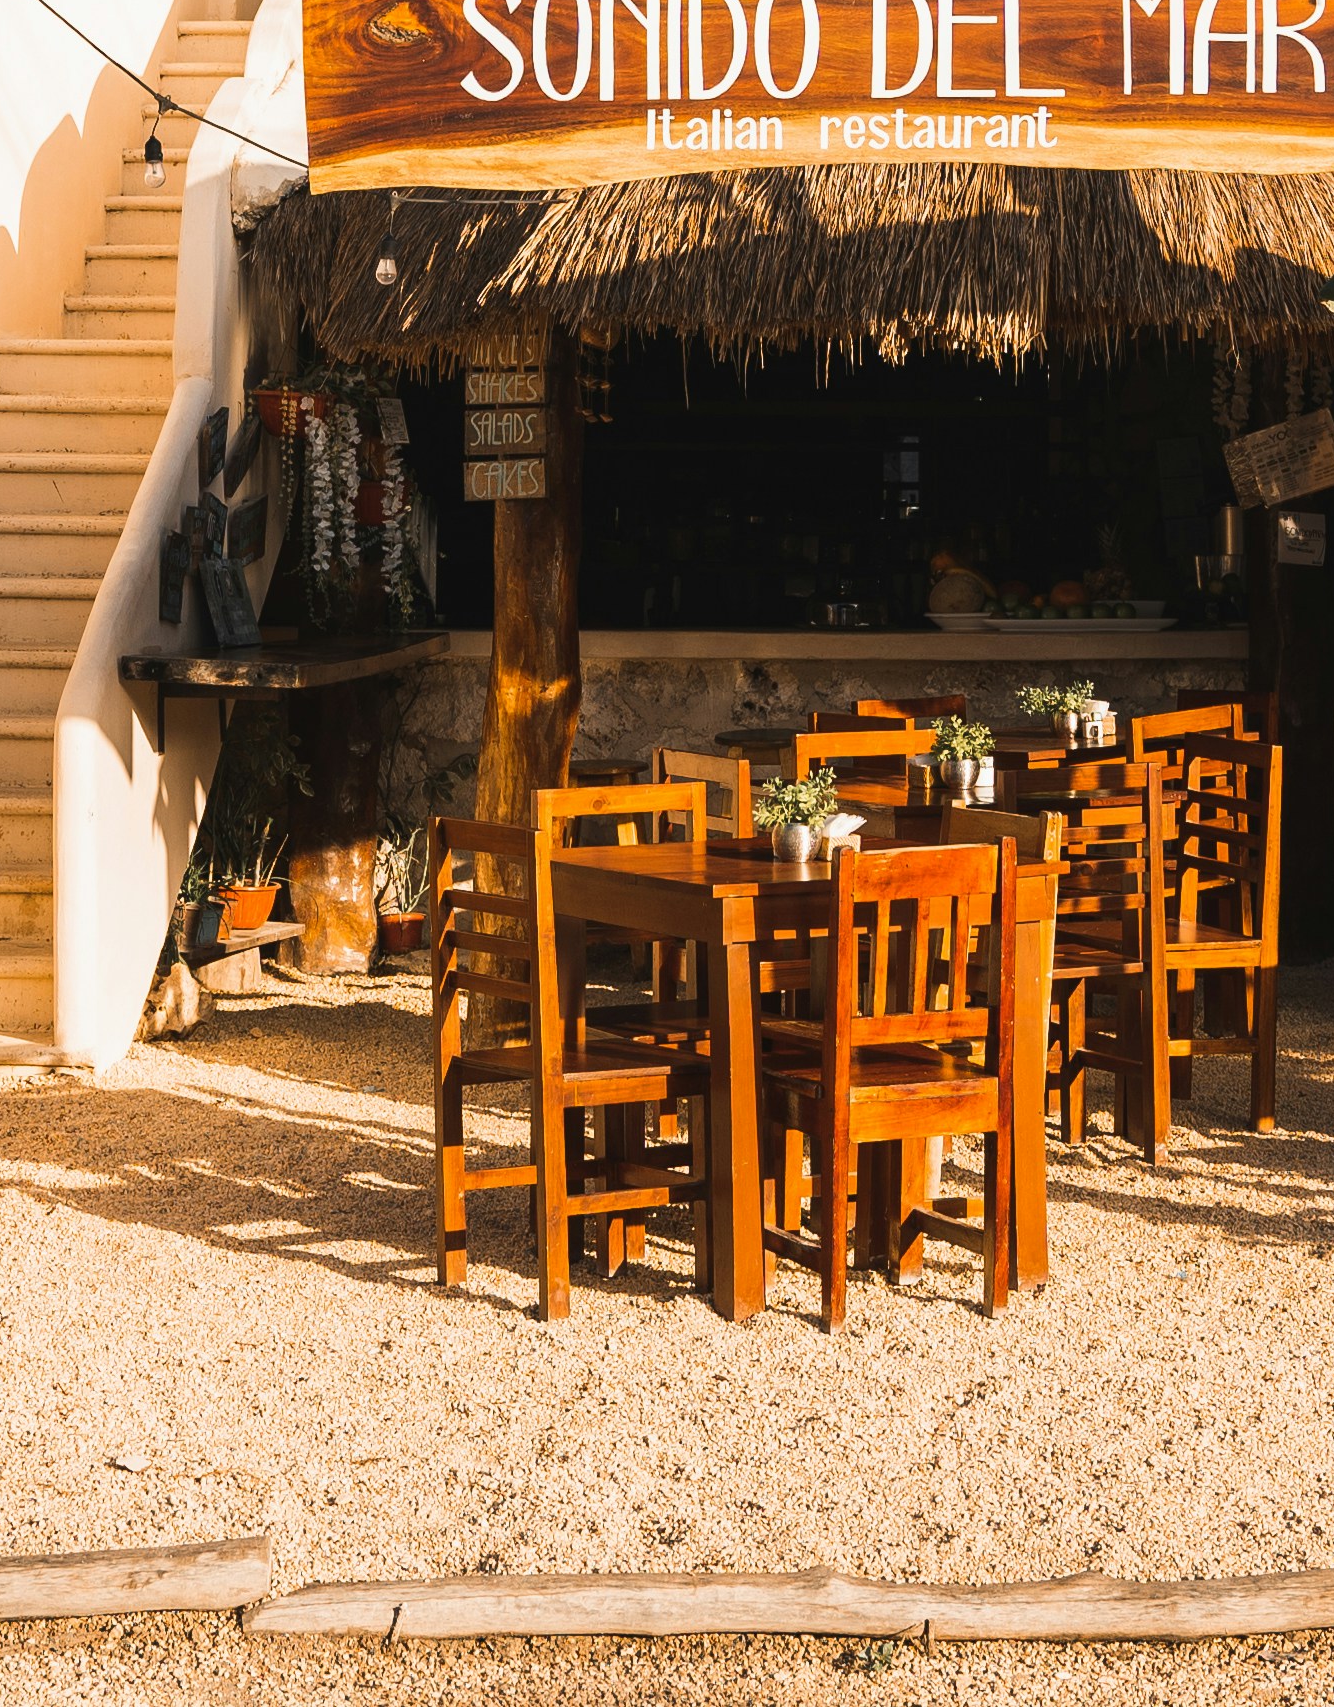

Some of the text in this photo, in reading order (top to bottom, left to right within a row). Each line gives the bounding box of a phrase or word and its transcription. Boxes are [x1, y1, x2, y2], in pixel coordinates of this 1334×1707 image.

[647, 106, 1058, 152] Italian restaurant
[468, 374, 538, 403] SHAKES
[470, 412, 538, 446] SALADS
[472, 461, 539, 499] CAKES
